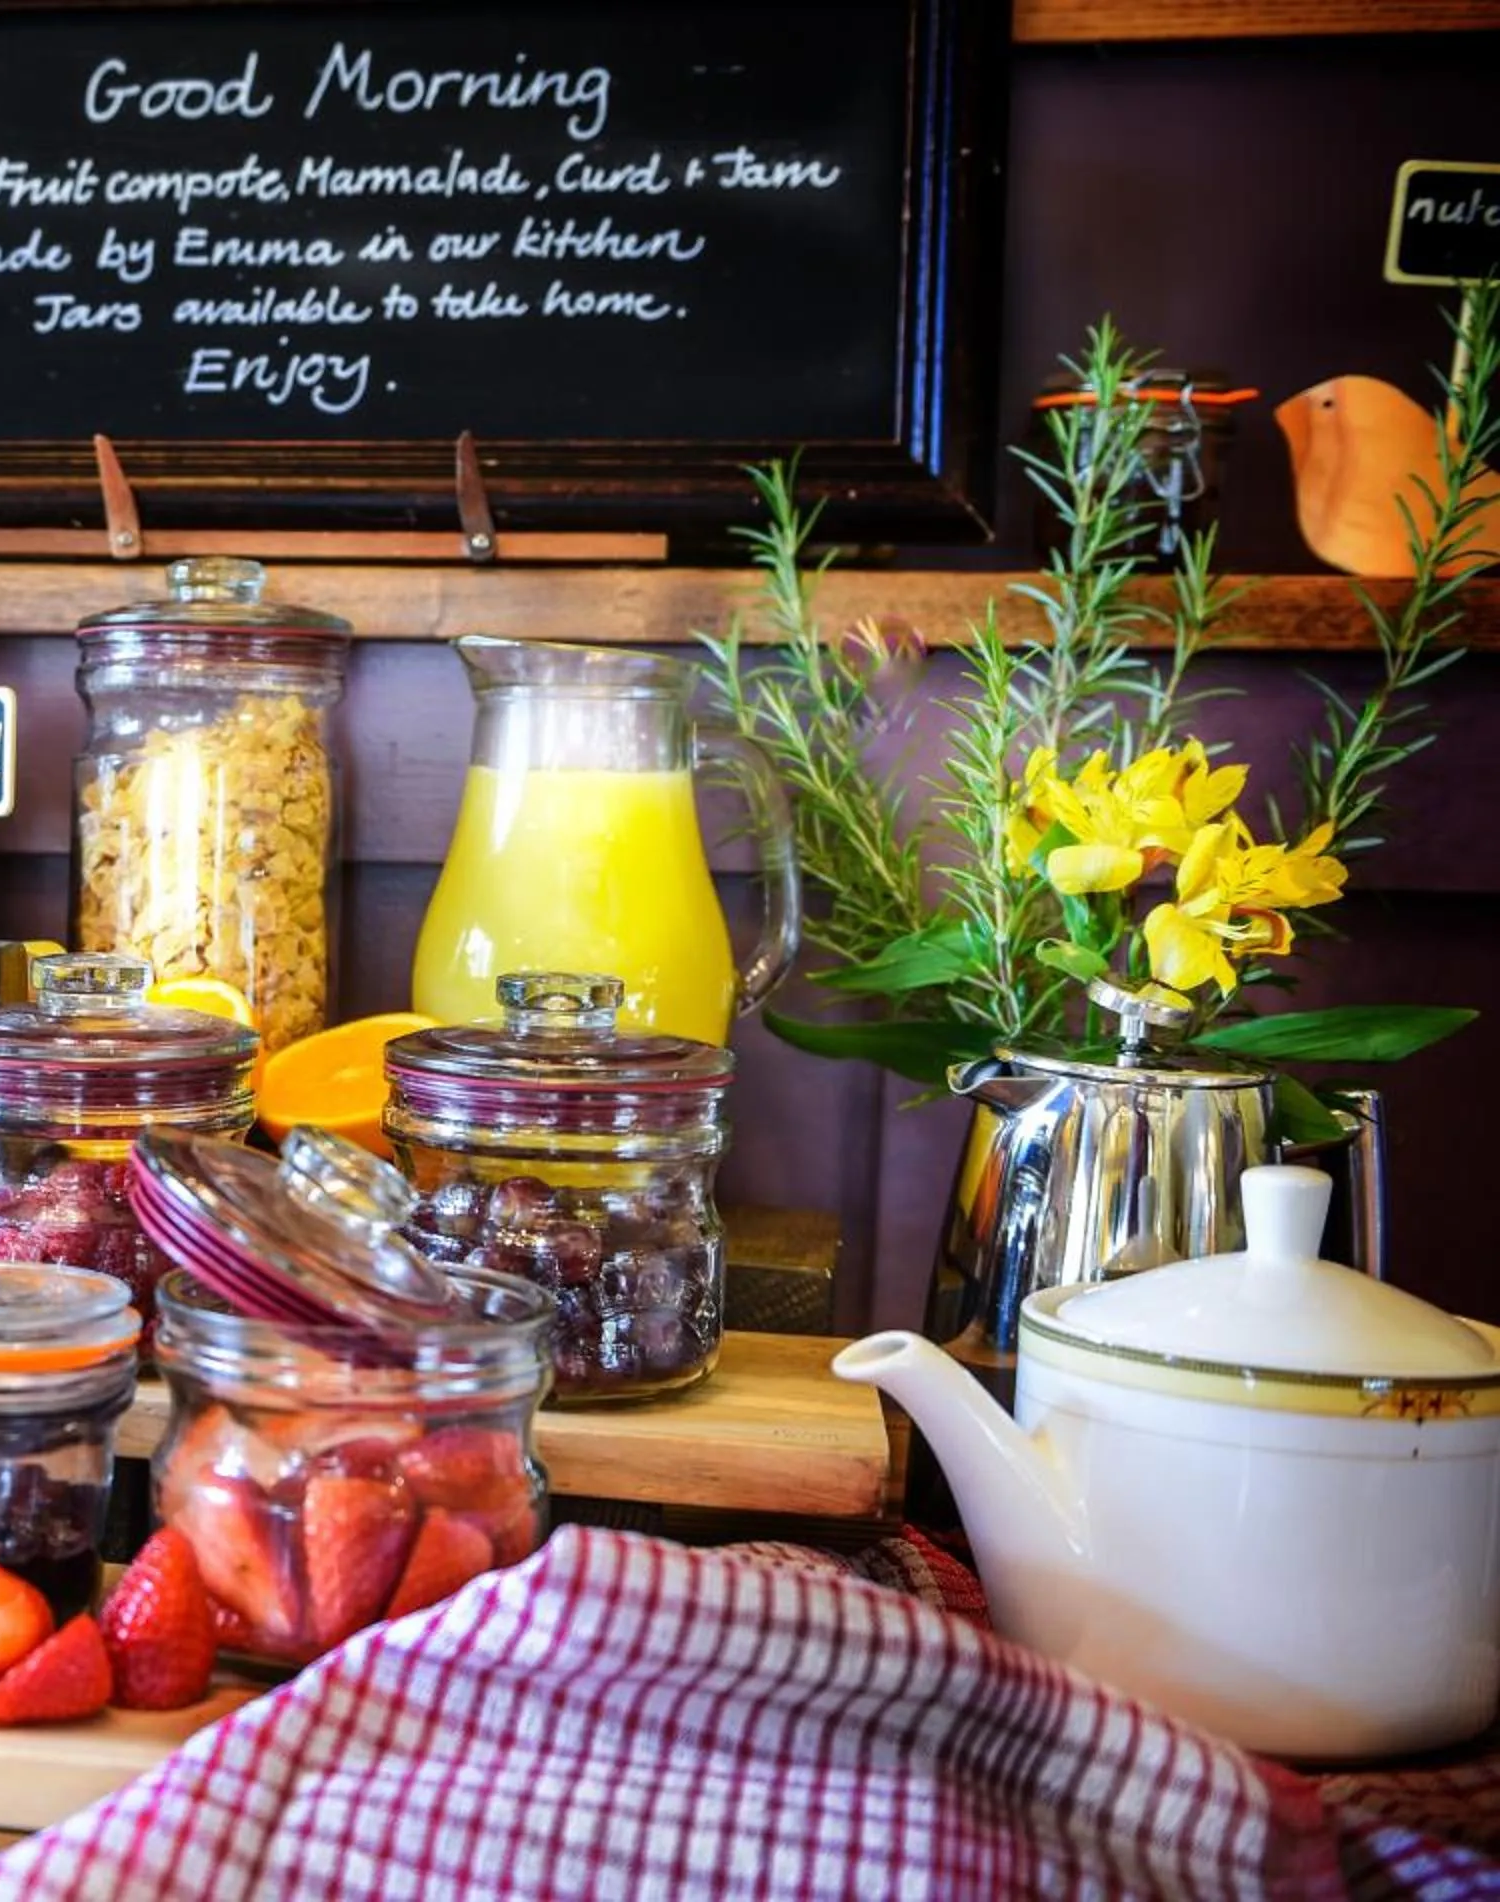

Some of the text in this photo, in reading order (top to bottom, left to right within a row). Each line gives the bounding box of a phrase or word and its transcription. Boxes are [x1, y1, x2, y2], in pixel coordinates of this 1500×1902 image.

[84, 42, 610, 140] Good Morning
[555, 152, 671, 194] Curd
[711, 145, 842, 190] Jam
[96, 229, 155, 282] by
[174, 227, 346, 268] Emma
[357, 225, 413, 263] in
[427, 232, 501, 262] our
[32, 280, 688, 332] Jars available to take home.
